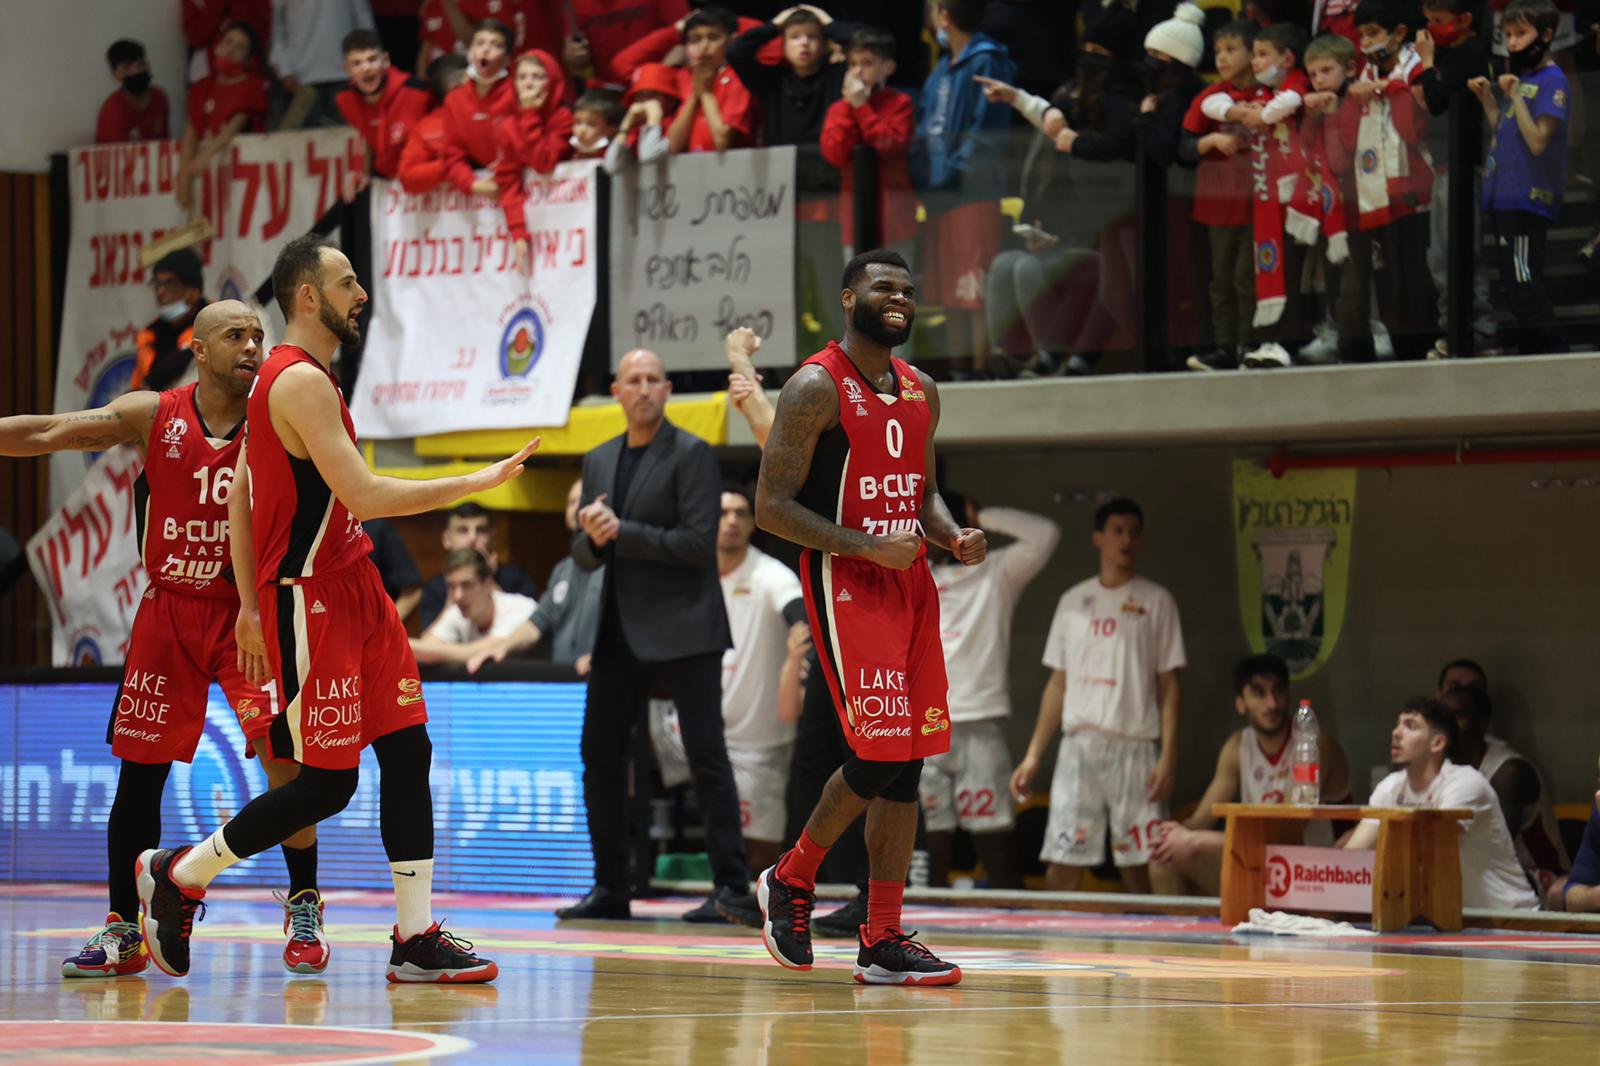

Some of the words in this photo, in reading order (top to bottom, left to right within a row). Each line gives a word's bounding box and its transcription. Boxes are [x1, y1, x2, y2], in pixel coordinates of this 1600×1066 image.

[79, 146, 152, 202] באושר
[886, 419, 904, 459] 0
[193, 466, 235, 505] 16
[160, 553, 223, 579] שובל
[1091, 617, 1118, 637] 10
[124, 665, 168, 697] LAKE
[316, 675, 359, 700] LAKE
[860, 668, 905, 691] LAKE
[117, 694, 171, 724] OUSE
[307, 700, 362, 727] HOUSE
[852, 695, 911, 717] HOUSE
[0, 764, 51, 823] חו
[958, 788, 996, 818] 22
[1294, 864, 1371, 885] Raichbach
